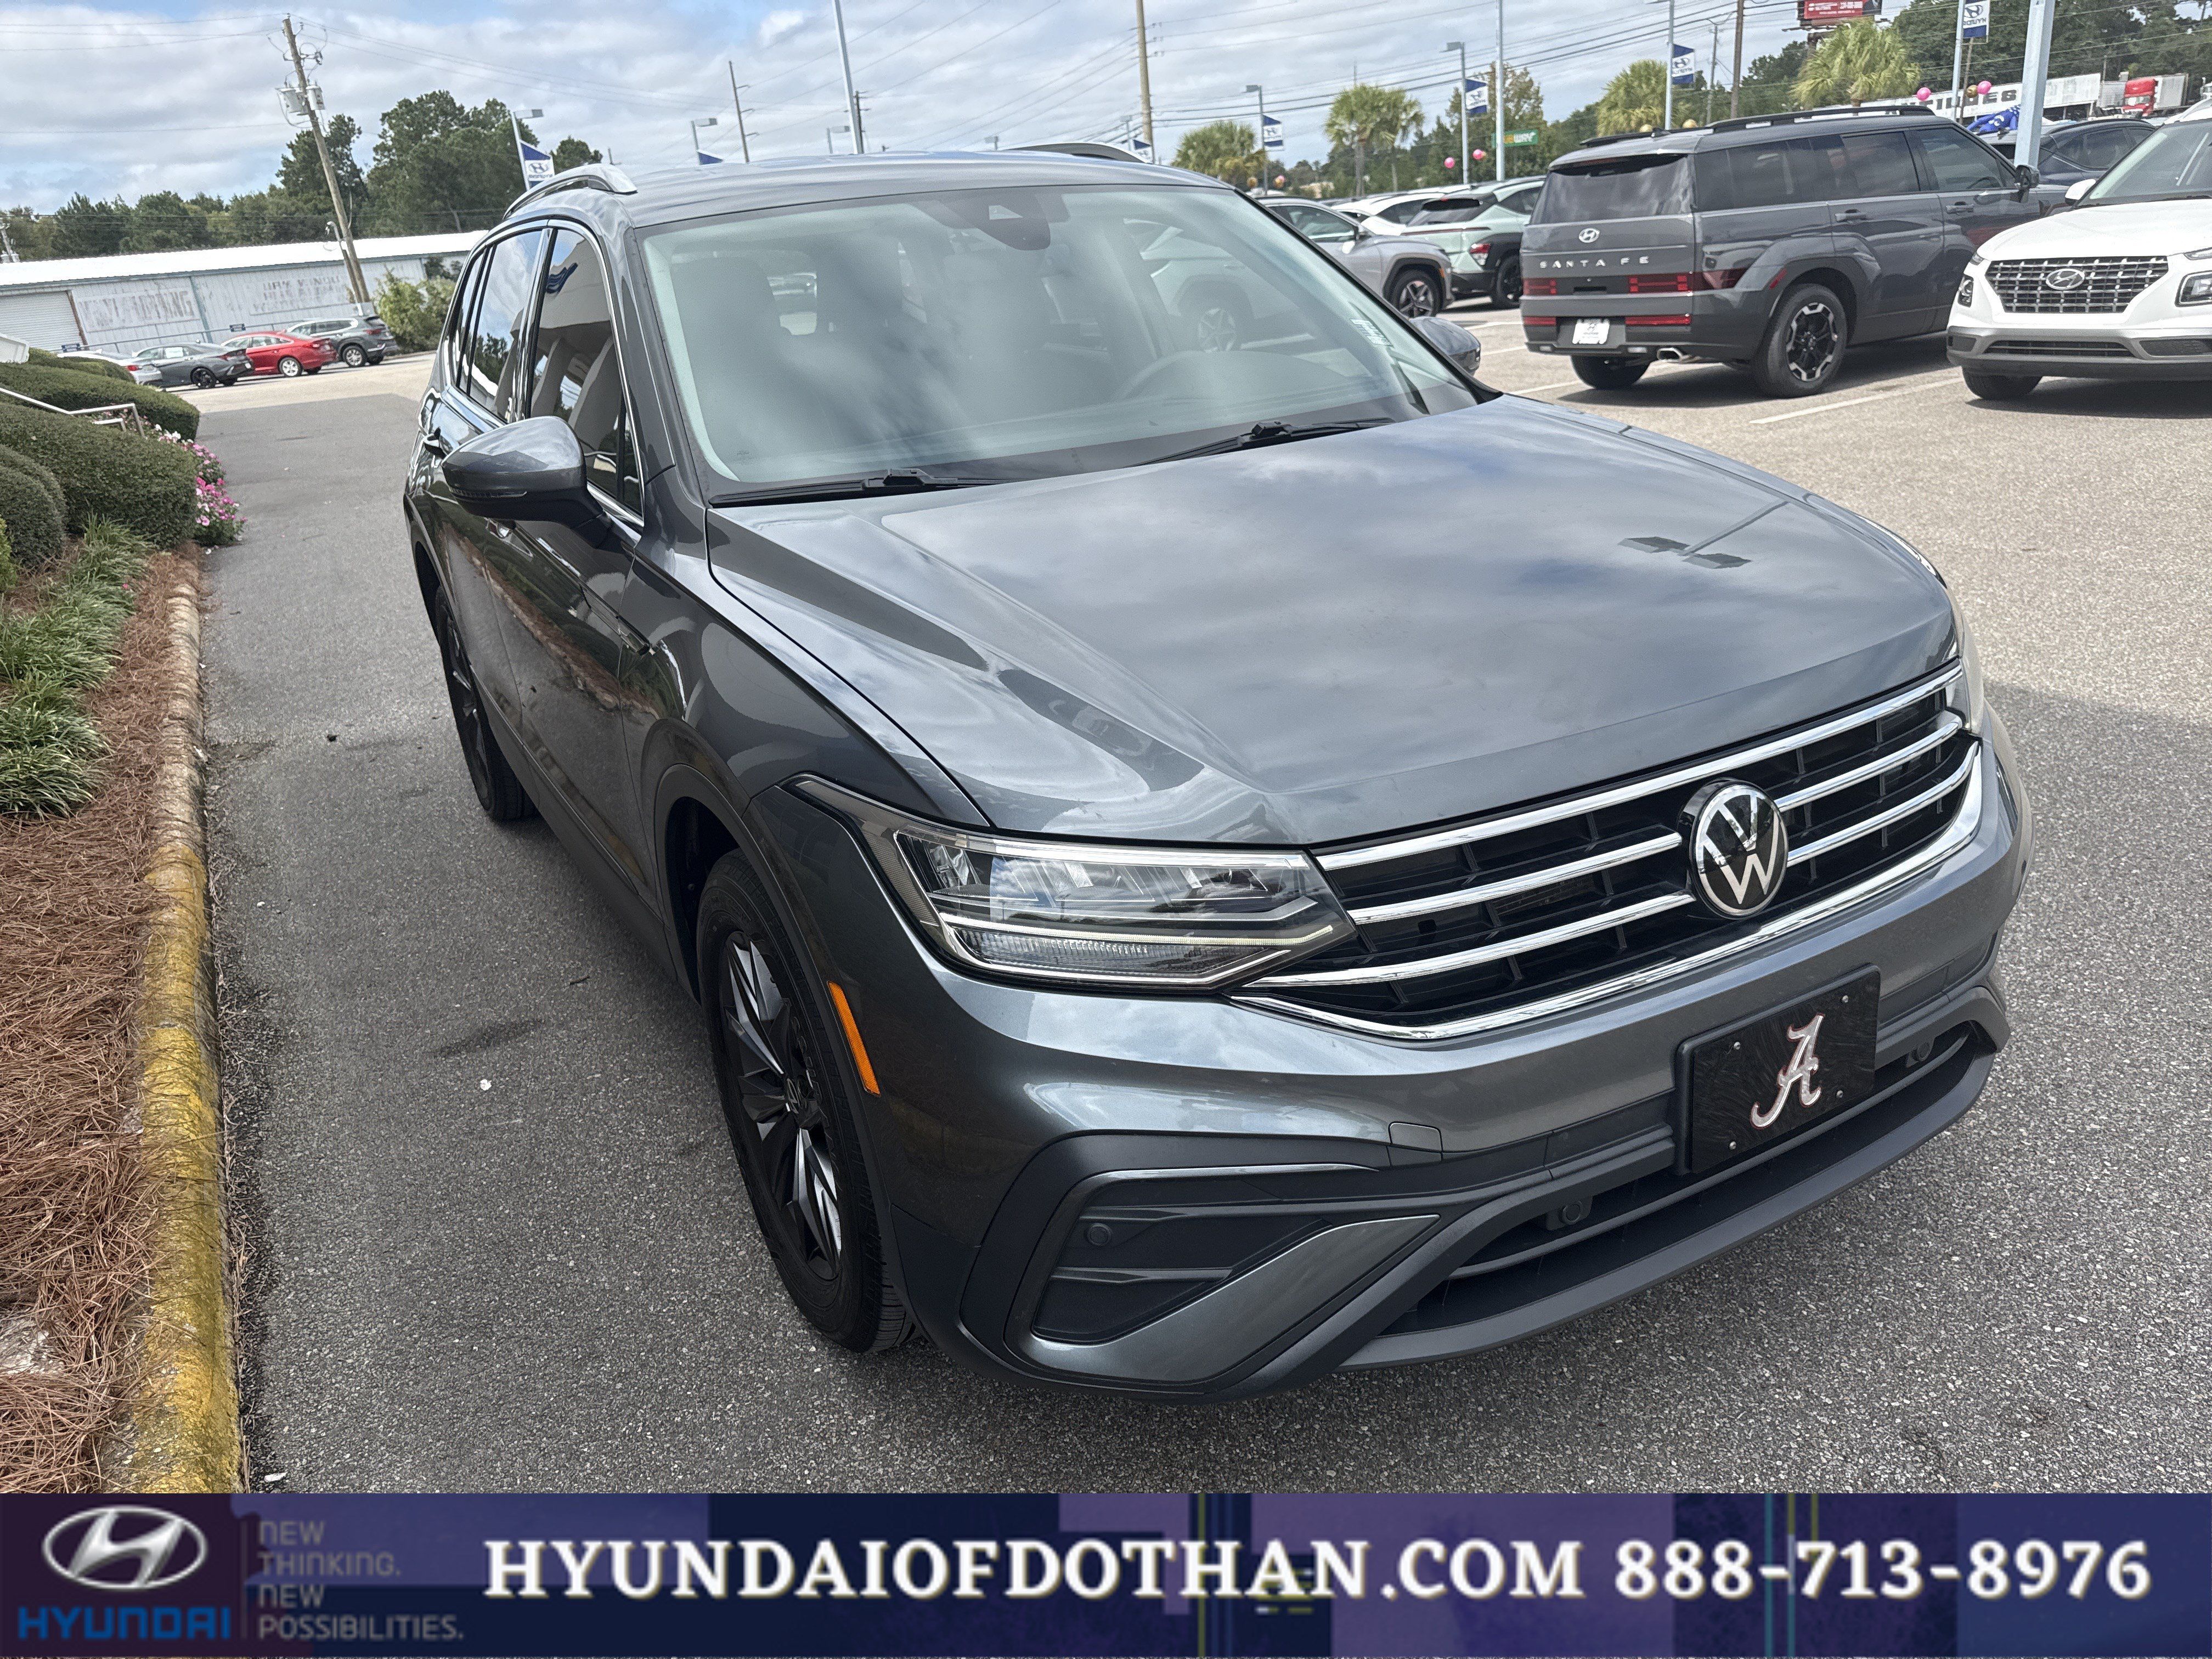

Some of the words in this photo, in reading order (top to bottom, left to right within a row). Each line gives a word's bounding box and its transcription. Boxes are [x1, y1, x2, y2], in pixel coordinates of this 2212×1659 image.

[1539, 259, 1606, 269] SANTA
[1620, 256, 1650, 266] FE
[1750, 1013, 1825, 1130] A
